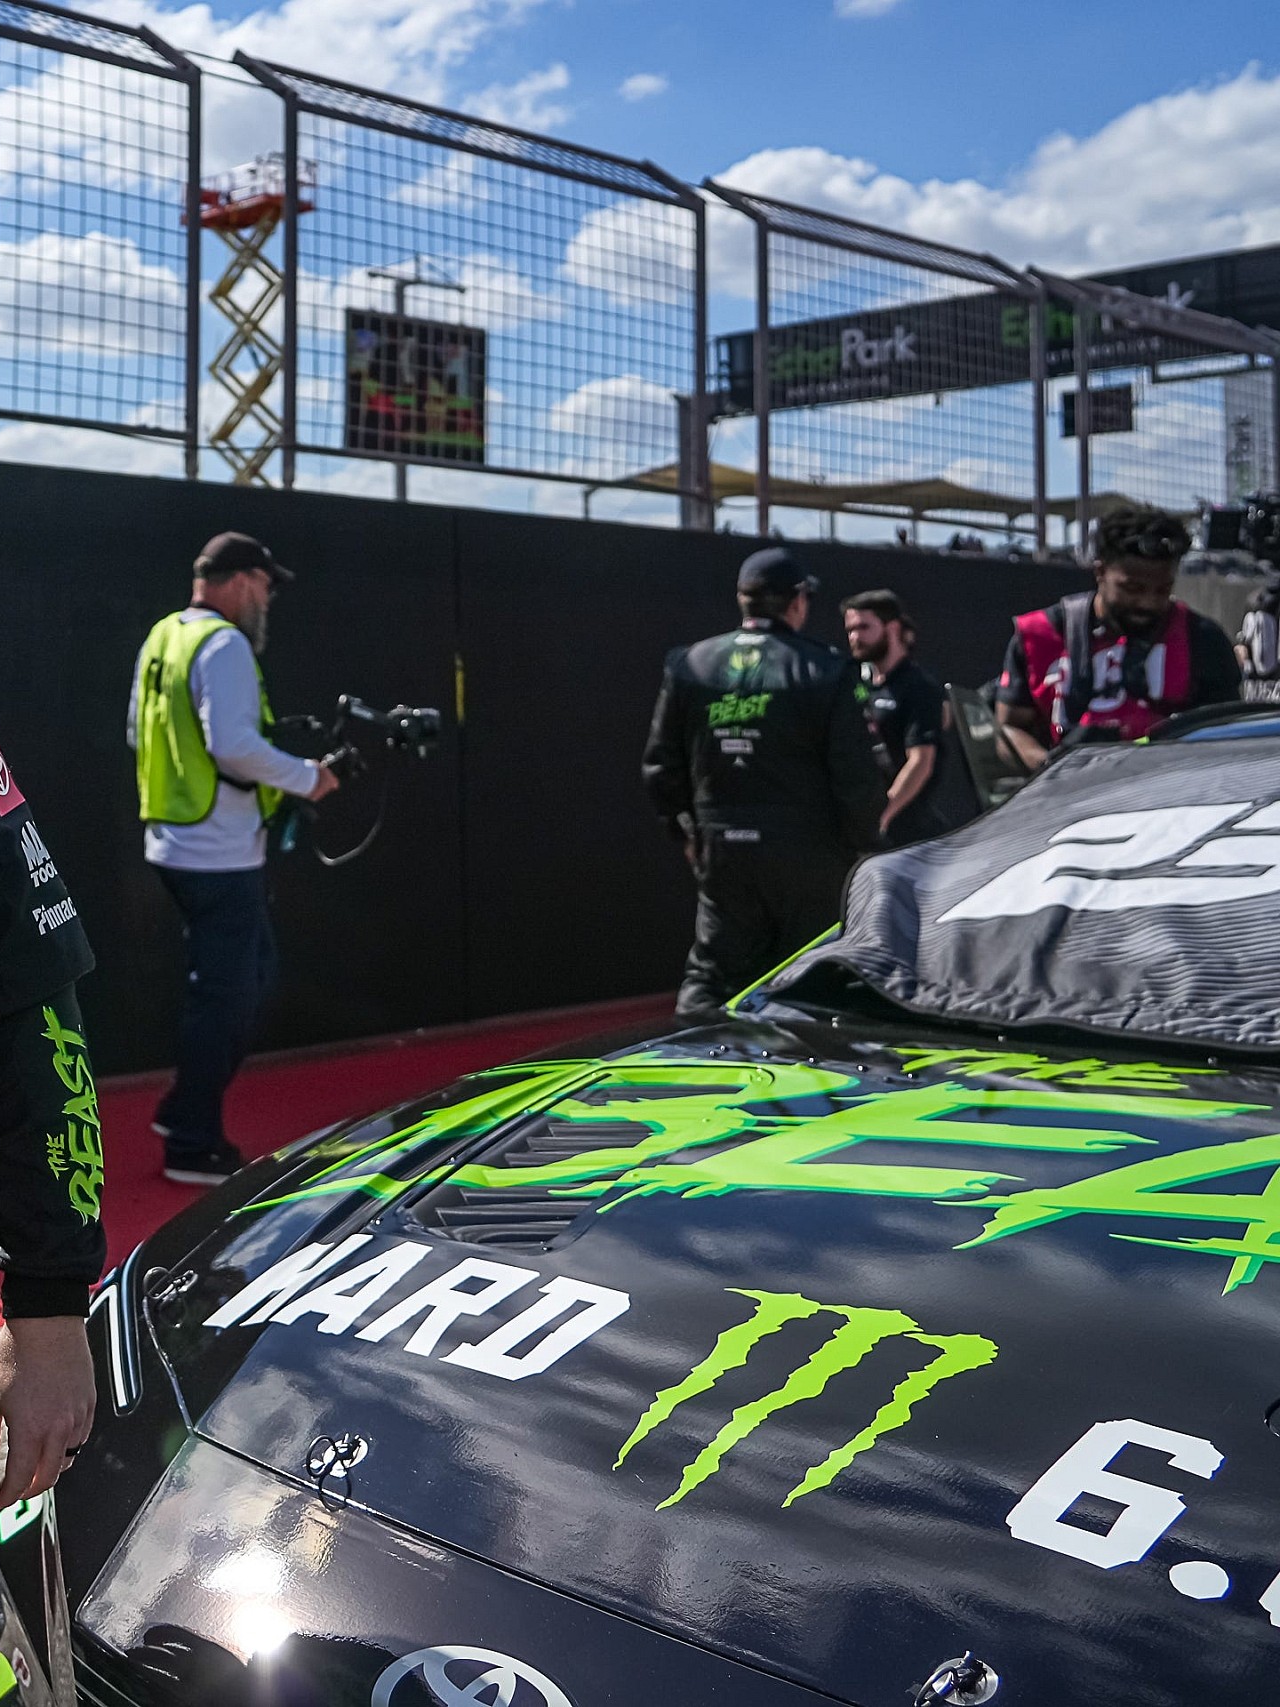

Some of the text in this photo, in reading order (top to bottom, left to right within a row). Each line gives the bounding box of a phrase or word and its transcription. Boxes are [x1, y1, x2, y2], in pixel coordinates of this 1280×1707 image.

[40, 1005, 105, 1227] BEAST
[892, 1047, 1230, 1091] THE
[46, 1133, 70, 1181] THE
[202, 1232, 632, 1382] HARD
